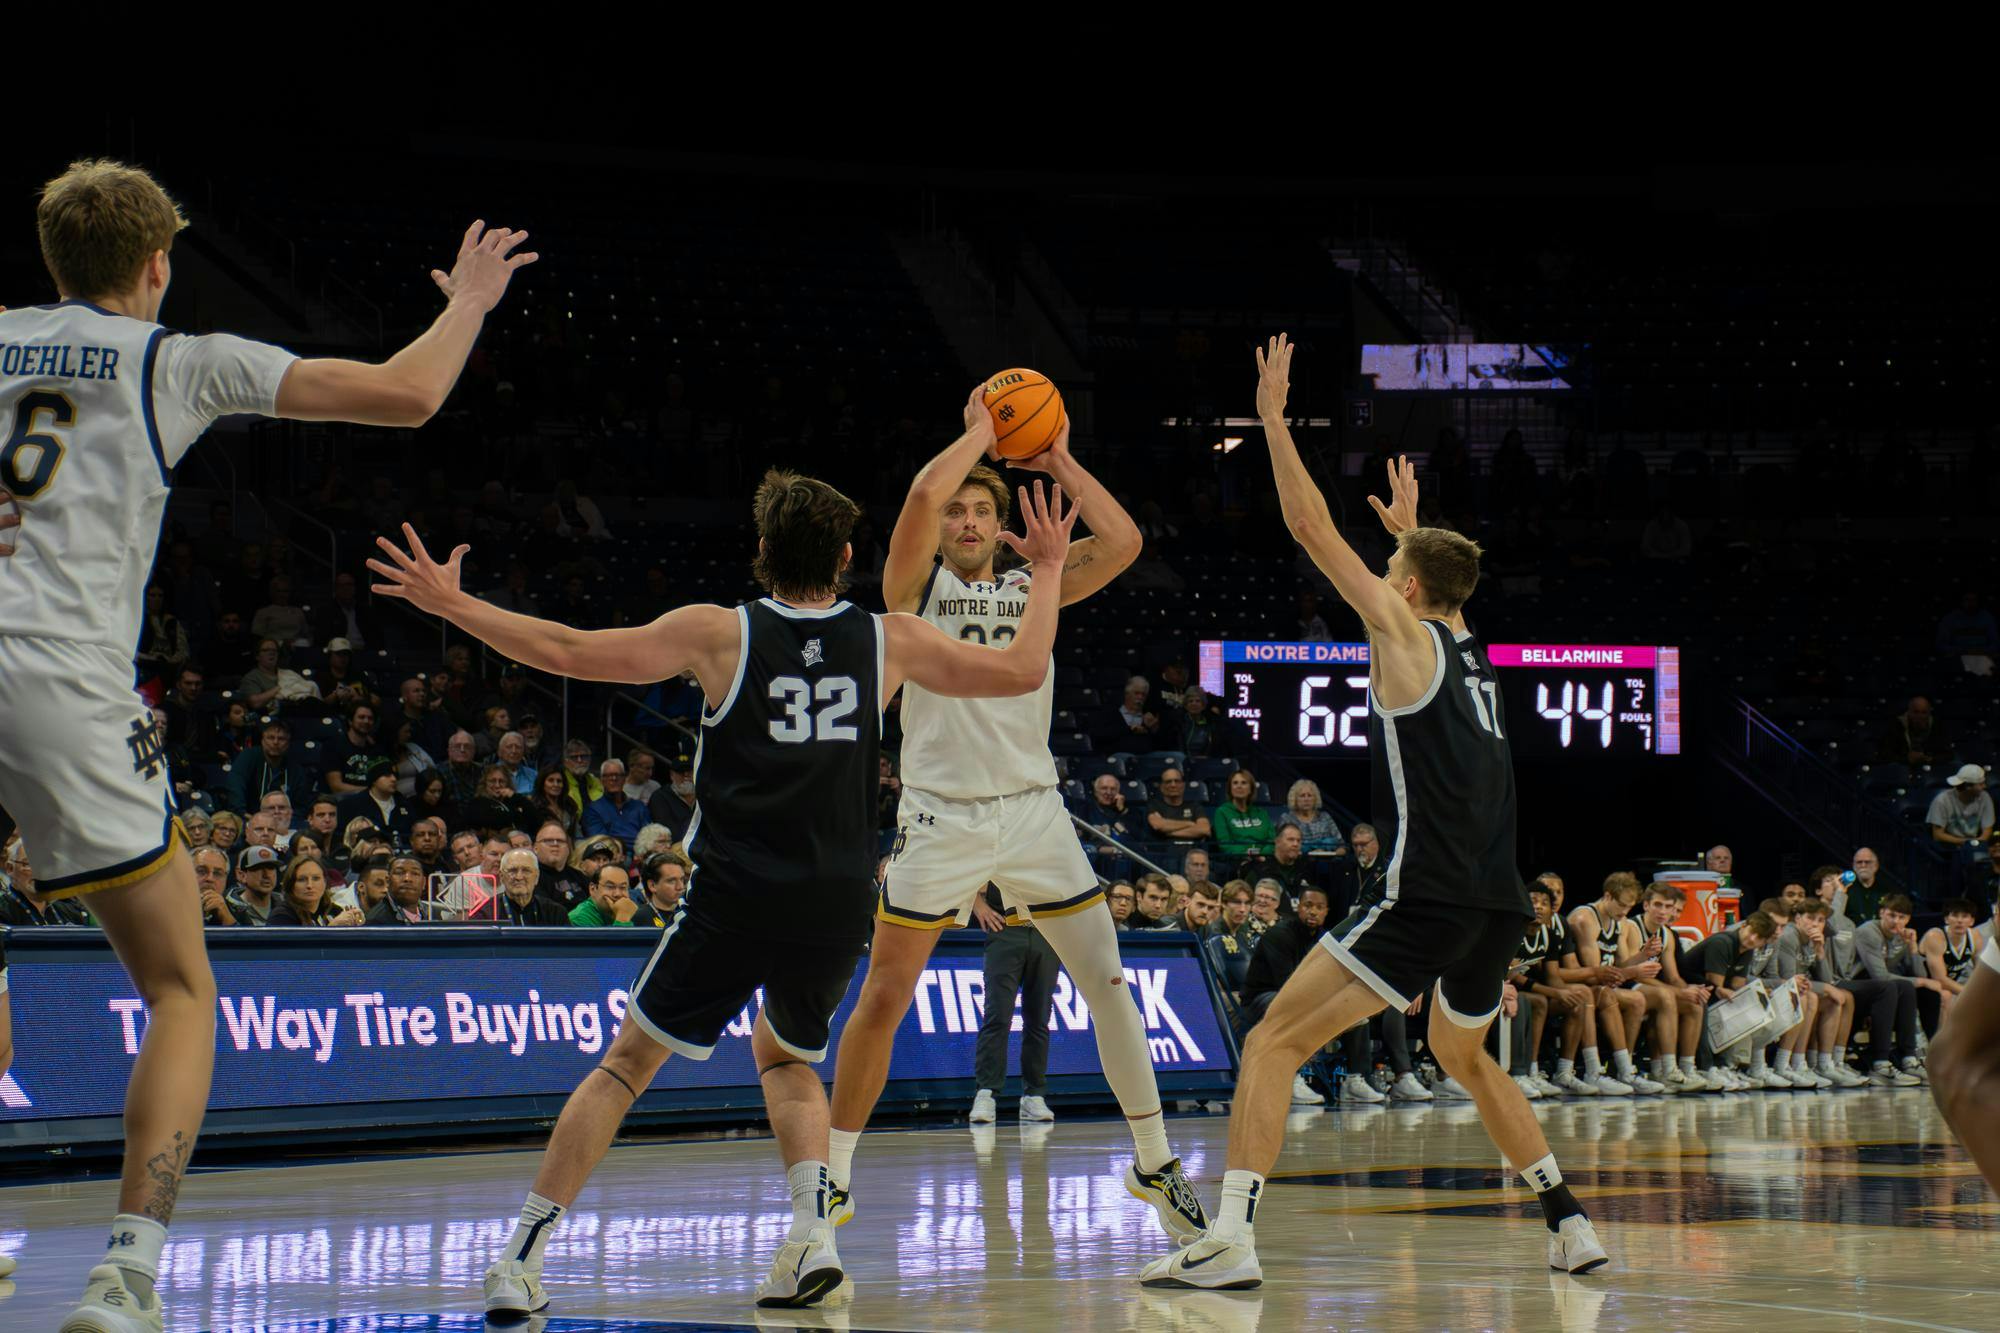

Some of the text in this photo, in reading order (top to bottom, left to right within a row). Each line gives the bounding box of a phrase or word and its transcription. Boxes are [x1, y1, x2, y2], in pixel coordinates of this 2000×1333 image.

[0, 343, 120, 380] OEHLER
[0, 387, 78, 501] 6
[938, 599, 1027, 618] NOTRE DAM
[1246, 645, 1369, 661] NOTRE DAME
[1522, 649, 1624, 664] BELLARMINE
[1234, 674, 1255, 684] TOL
[1625, 678, 1646, 689] TOL
[1238, 685, 1249, 706] 3
[1631, 690, 1644, 709] 2
[769, 676, 858, 742] 32
[1228, 708, 1261, 718] FOULS
[1299, 676, 1370, 747] 62
[1465, 676, 1504, 739] 11
[1537, 680, 1614, 749] 44
[1619, 713, 1652, 723] FOULS
[1246, 720, 1259, 741] 7
[1637, 724, 1652, 751] 7
[219, 995, 338, 1063] Way
[343, 991, 438, 1047] Tire
[445, 989, 603, 1056] Buying
